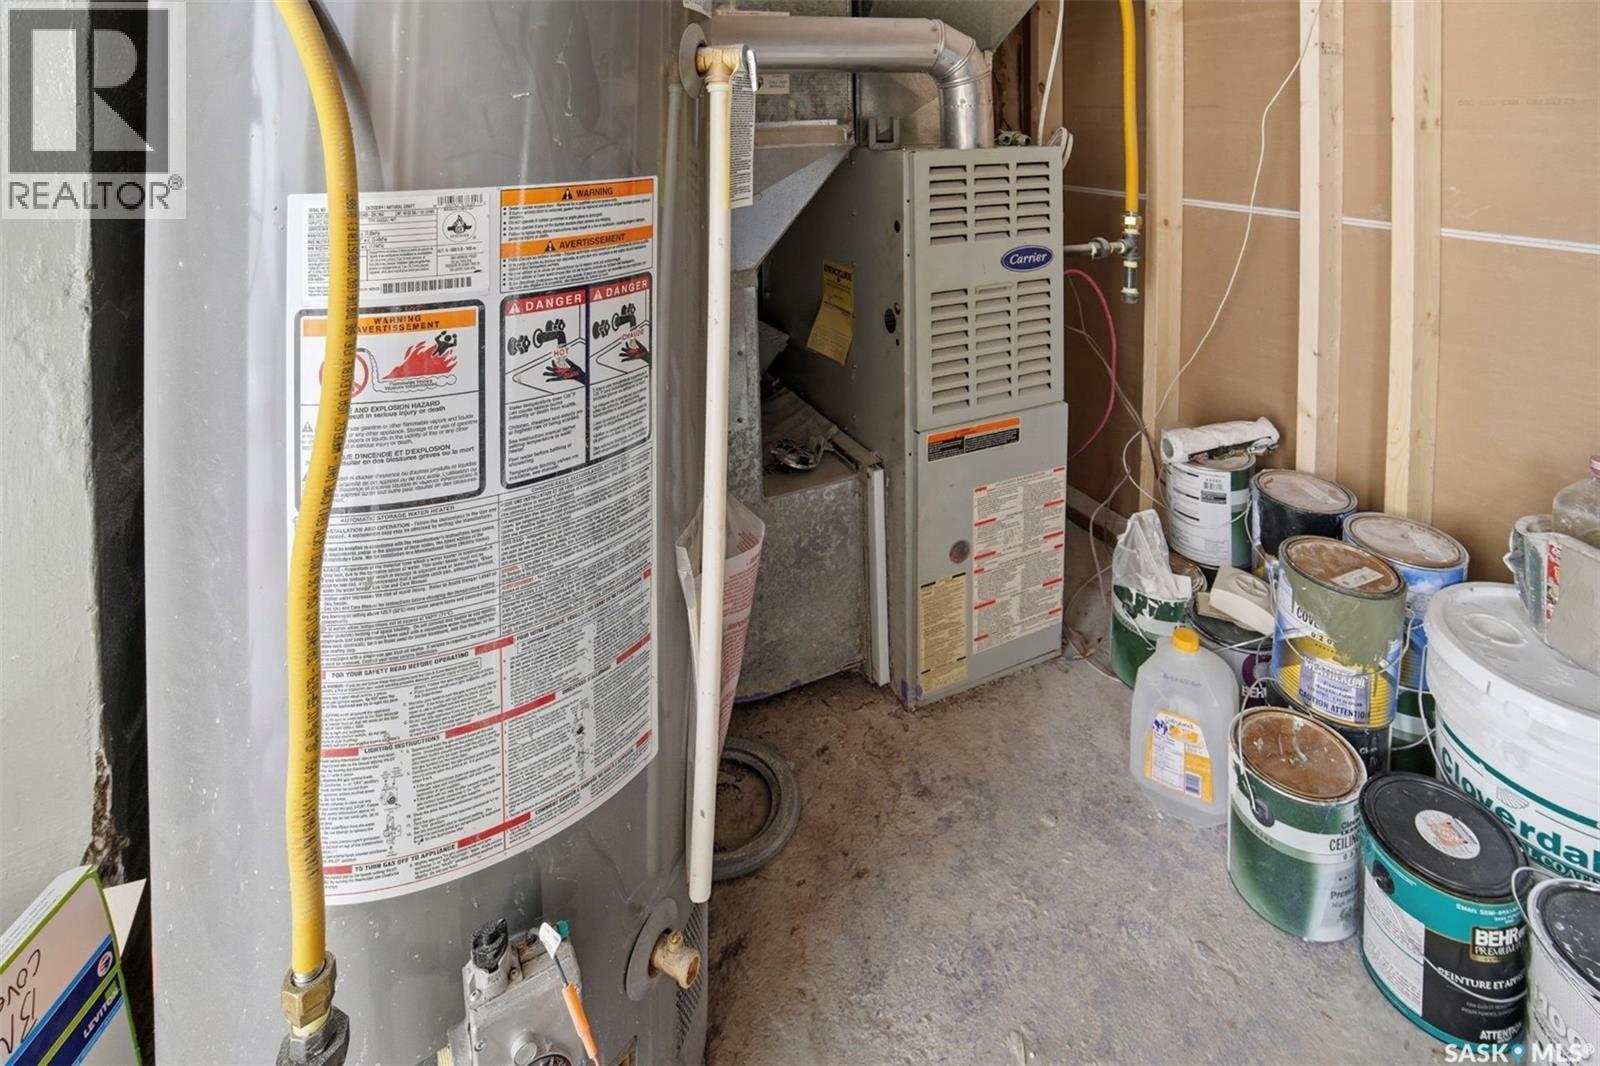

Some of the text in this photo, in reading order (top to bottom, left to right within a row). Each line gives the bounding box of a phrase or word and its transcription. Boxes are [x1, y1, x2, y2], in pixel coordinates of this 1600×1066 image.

[576, 186, 614, 198] WARNING
[559, 232, 626, 249] AVERTISSEMENT
[1010, 252, 1048, 265] Carrier
[606, 279, 648, 298] DANGER
[525, 294, 582, 312] DANGER
[374, 315, 422, 324] WARNING
[356, 320, 440, 334] AVERTISSEMENT
[554, 348, 569, 356] HOT
[371, 404, 410, 412] EXPLOSION
[411, 400, 440, 409] HAZARD
[399, 409, 417, 417] injury
[354, 450, 392, 460] D'INCENDIE
[405, 444, 451, 456] D'EXPLOSION
[377, 512, 406, 520] STORAGE
[408, 510, 429, 518] WATER
[431, 506, 455, 515] HEATER
[364, 668, 388, 676] SAFETY
[408, 660, 433, 670] BEFORE
[435, 652, 469, 664] OPERATING
[395, 735, 440, 750] INSTRUCTIONS
[383, 861, 396, 869] GAS
[411, 854, 420, 862] TO
[420, 844, 456, 860] APPLIANCE
[1475, 927, 1519, 947] BEHR
